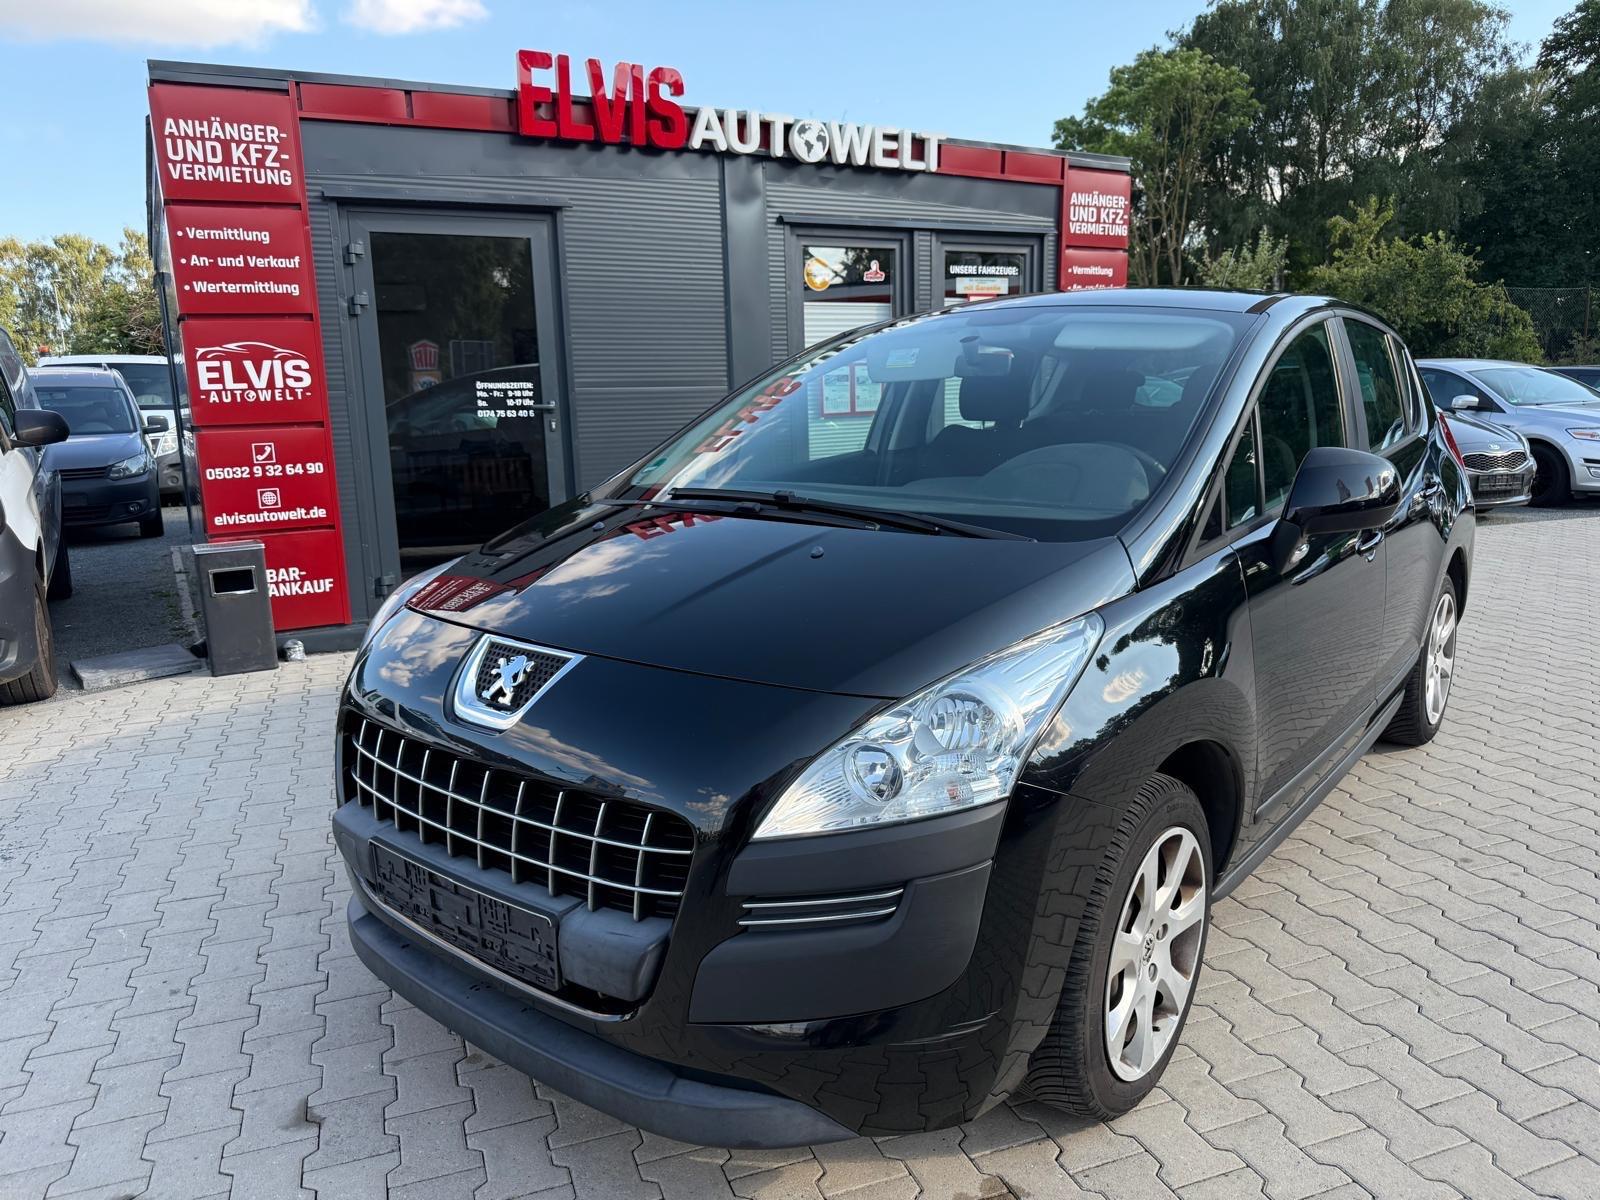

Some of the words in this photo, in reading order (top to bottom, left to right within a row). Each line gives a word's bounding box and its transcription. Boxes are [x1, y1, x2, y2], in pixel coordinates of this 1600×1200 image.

[516, 49, 686, 149] ELVIS
[164, 116, 287, 144] ANHÄNGER-
[165, 138, 222, 164] UND
[231, 143, 290, 168] KFZ-
[168, 163, 292, 186] VERMIETUNG
[1070, 191, 1128, 208] ANHÄNGER-
[1070, 205, 1097, 222] UND
[1100, 207, 1128, 224] KFZ-
[185, 226, 270, 244] Vermittlung
[1069, 221, 1128, 236] VERMIETUNG
[190, 255, 214, 267] An-
[217, 255, 244, 267] und
[246, 255, 301, 268] Verkauf
[950, 264, 978, 274] UNSERE
[978, 265, 1019, 275] FAHRZEUGE:
[1072, 265, 1113, 277] Vermittlung
[193, 280, 300, 296] Wertermittlung
[196, 359, 312, 390] ELVIS
[205, 465, 250, 480] 05032
[253, 465, 263, 477] 9
[265, 464, 283, 477] 32
[285, 463, 304, 476] 64
[306, 462, 324, 475] 90
[214, 507, 327, 526] elvisautowelt.de
[266, 567, 307, 583] BAR-
